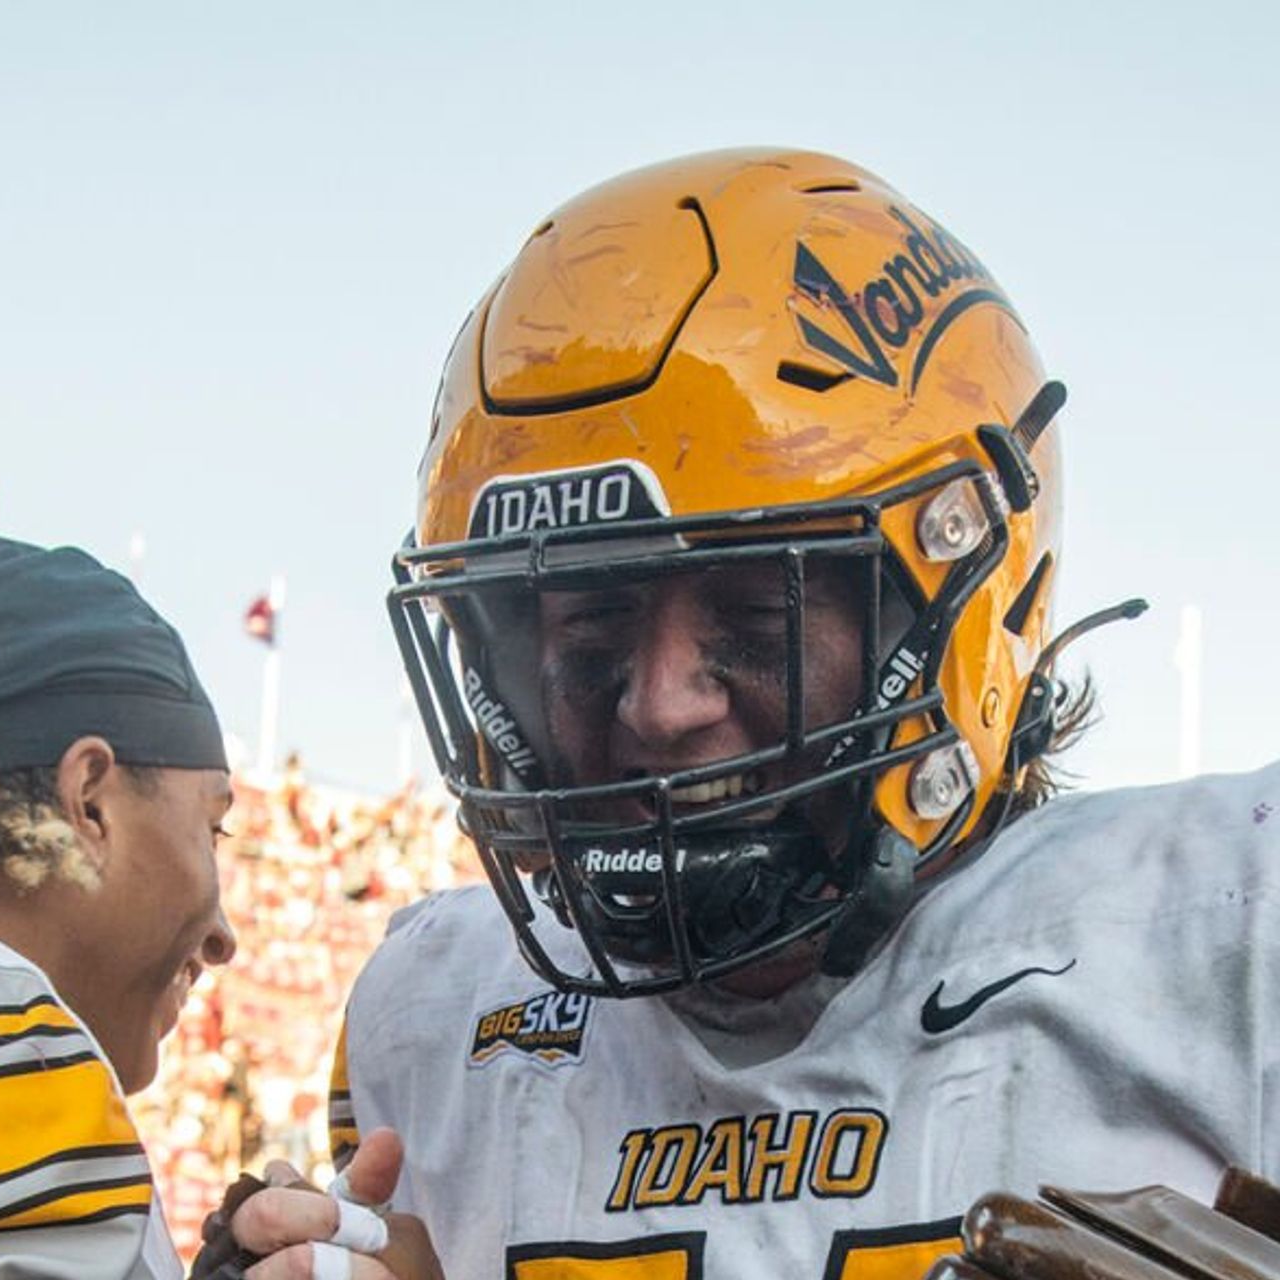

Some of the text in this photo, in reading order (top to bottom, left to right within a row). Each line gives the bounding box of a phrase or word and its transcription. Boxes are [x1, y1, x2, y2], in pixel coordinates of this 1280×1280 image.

[794, 204, 992, 387] Vand
[486, 473, 631, 538] IDAHO
[586, 848, 687, 873] Riddel
[605, 1106, 890, 1213] IDAHO
